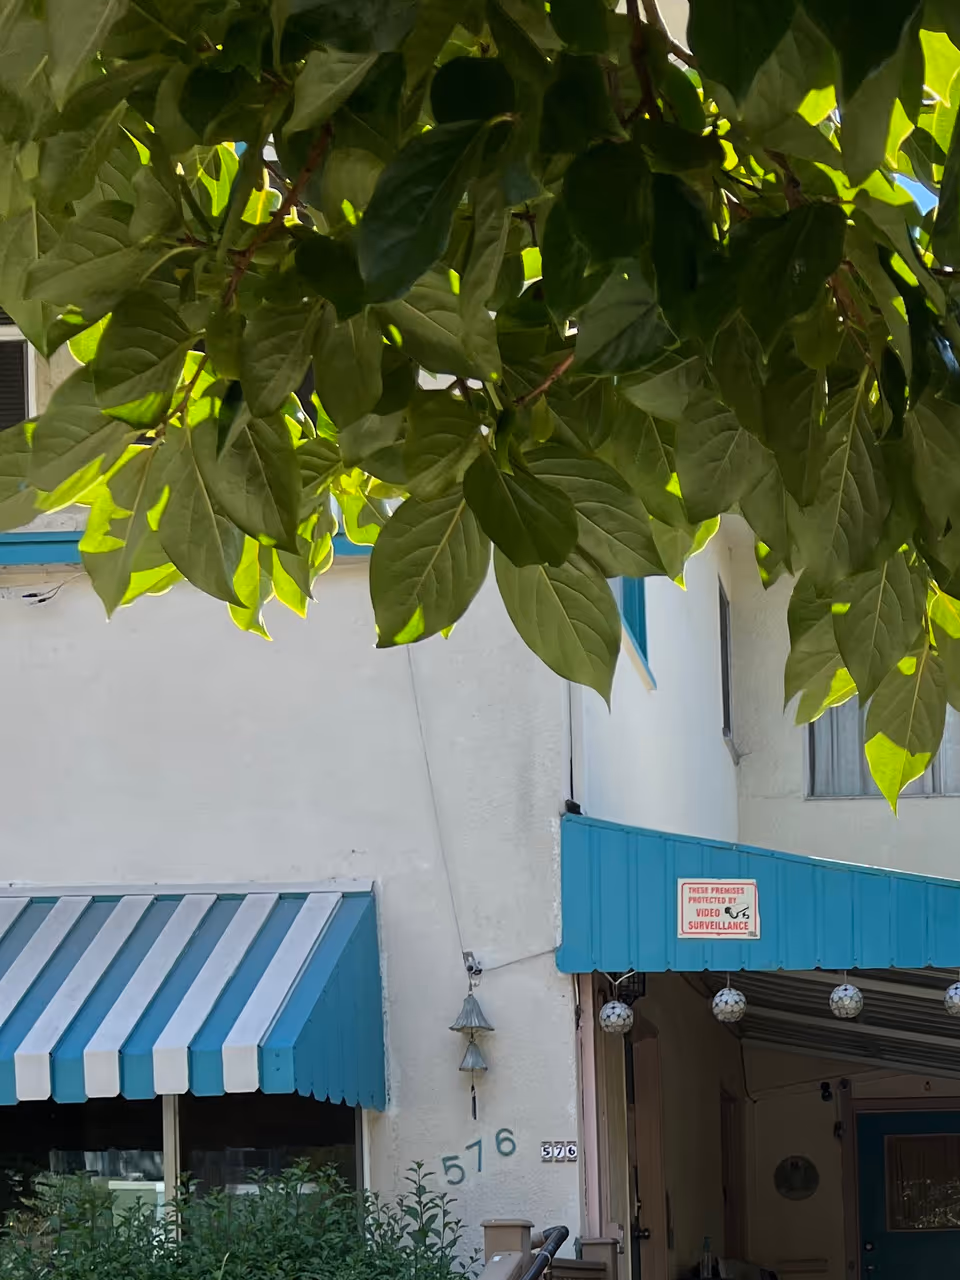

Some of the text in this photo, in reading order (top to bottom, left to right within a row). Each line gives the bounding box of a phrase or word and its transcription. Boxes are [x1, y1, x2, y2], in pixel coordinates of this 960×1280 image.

[696, 908, 720, 917] VIDEO
[688, 921, 749, 930] SURVEILLANCE
[442, 1128, 516, 1185] 576
[542, 1145, 576, 1158] 576
